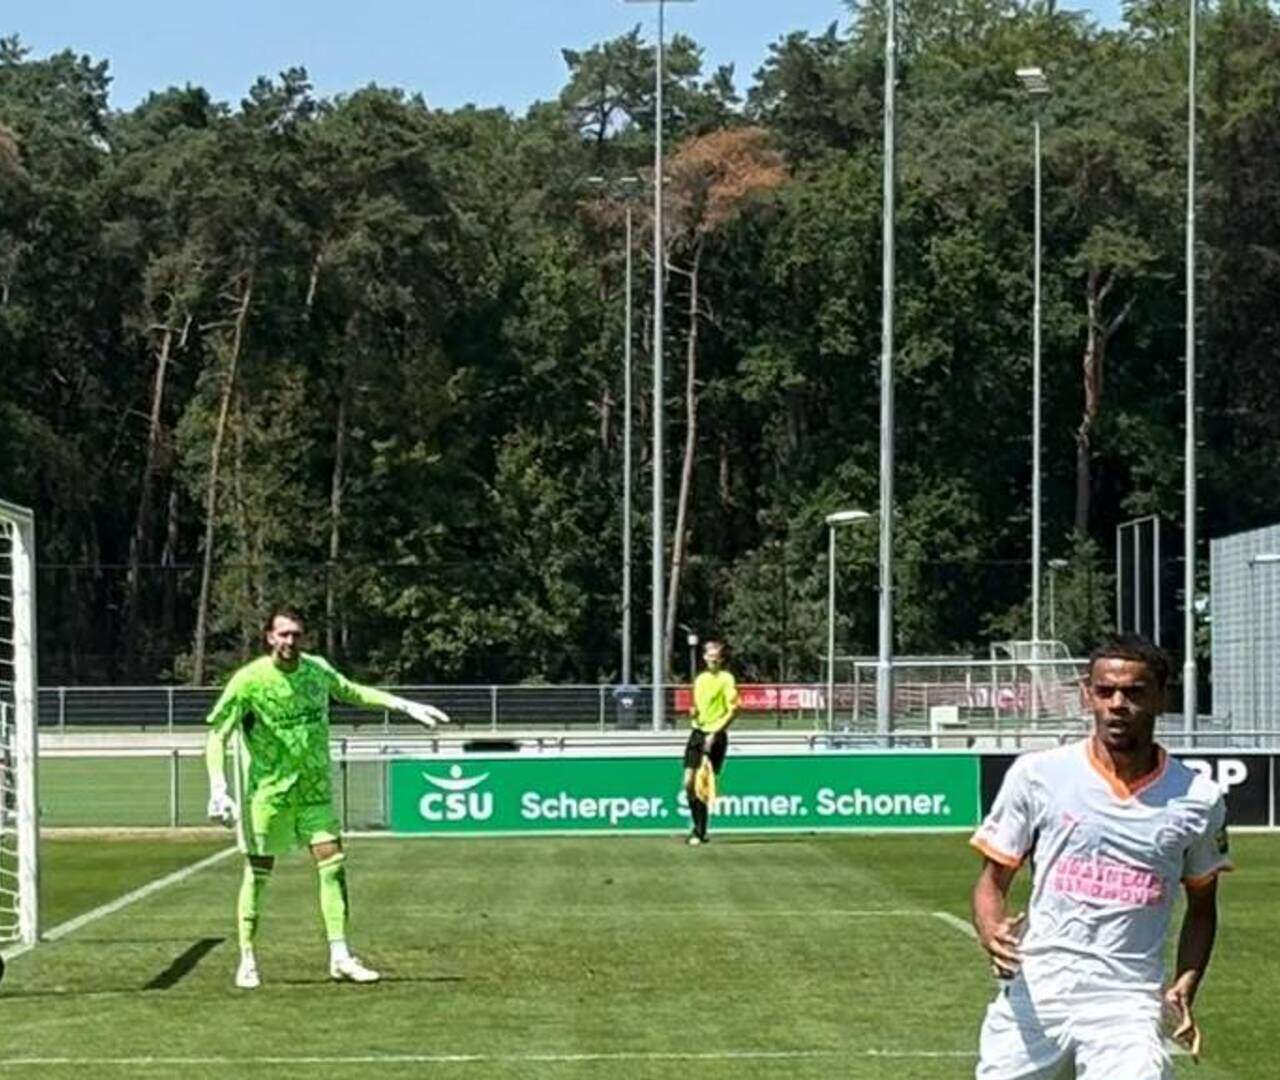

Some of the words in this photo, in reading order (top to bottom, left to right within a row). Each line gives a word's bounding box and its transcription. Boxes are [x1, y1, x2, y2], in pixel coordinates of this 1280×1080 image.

[420, 791, 493, 821] CSU
[521, 791, 668, 824] Scherper.
[677, 792, 808, 816] Simmer.
[816, 788, 950, 816] Schoner.
